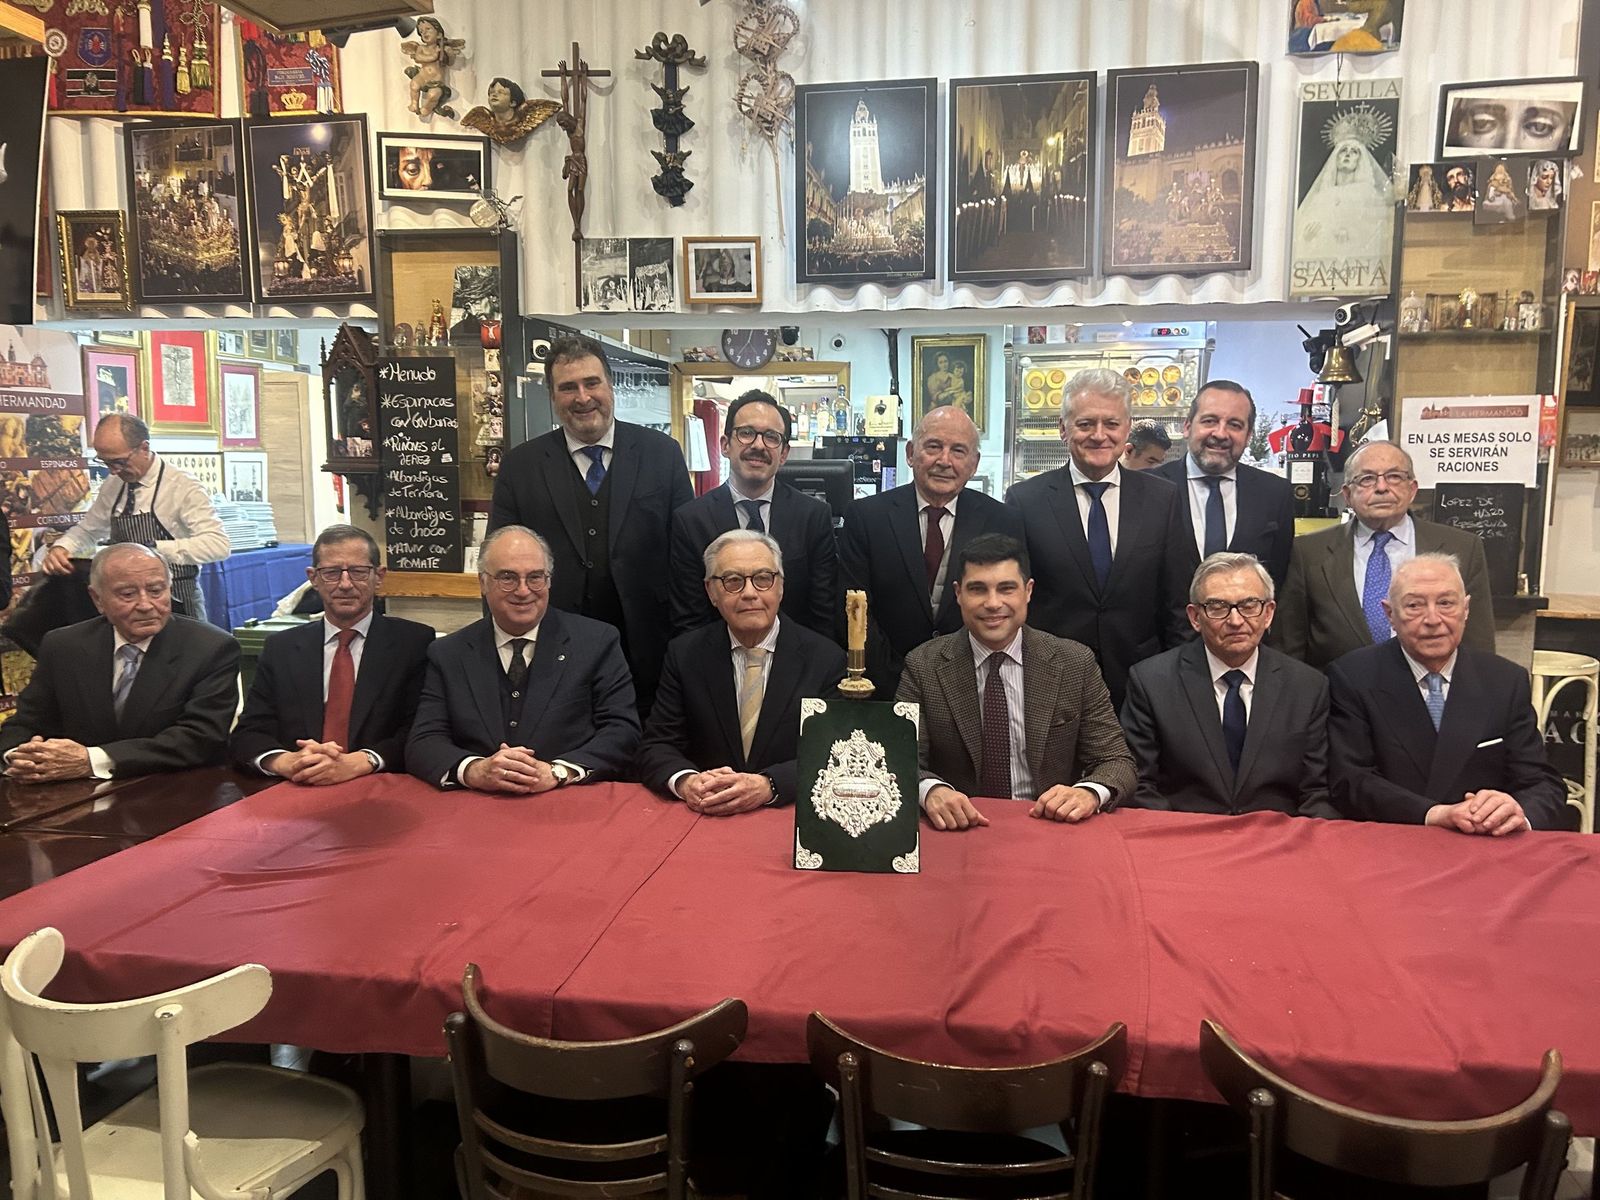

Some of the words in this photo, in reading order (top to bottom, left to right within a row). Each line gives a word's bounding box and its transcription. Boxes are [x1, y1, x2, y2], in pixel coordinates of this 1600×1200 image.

[1303, 80, 1399, 100] SEVILLA
[1293, 266, 1388, 287] SANTA
[766, 338, 772, 346] 3
[0, 394, 67, 409] ERMANDAD
[1408, 433, 1424, 444] EN
[1427, 433, 1450, 444] LAS
[1453, 432, 1495, 443] MESAS
[1498, 431, 1532, 443] SOLO
[1429, 447, 1445, 458] SE
[1448, 444, 1508, 458] SERVIRÁN
[40, 460, 78, 469] ESPINACAS
[1437, 461, 1499, 472] RACIONES
[396, 556, 441, 569] TOMATE
